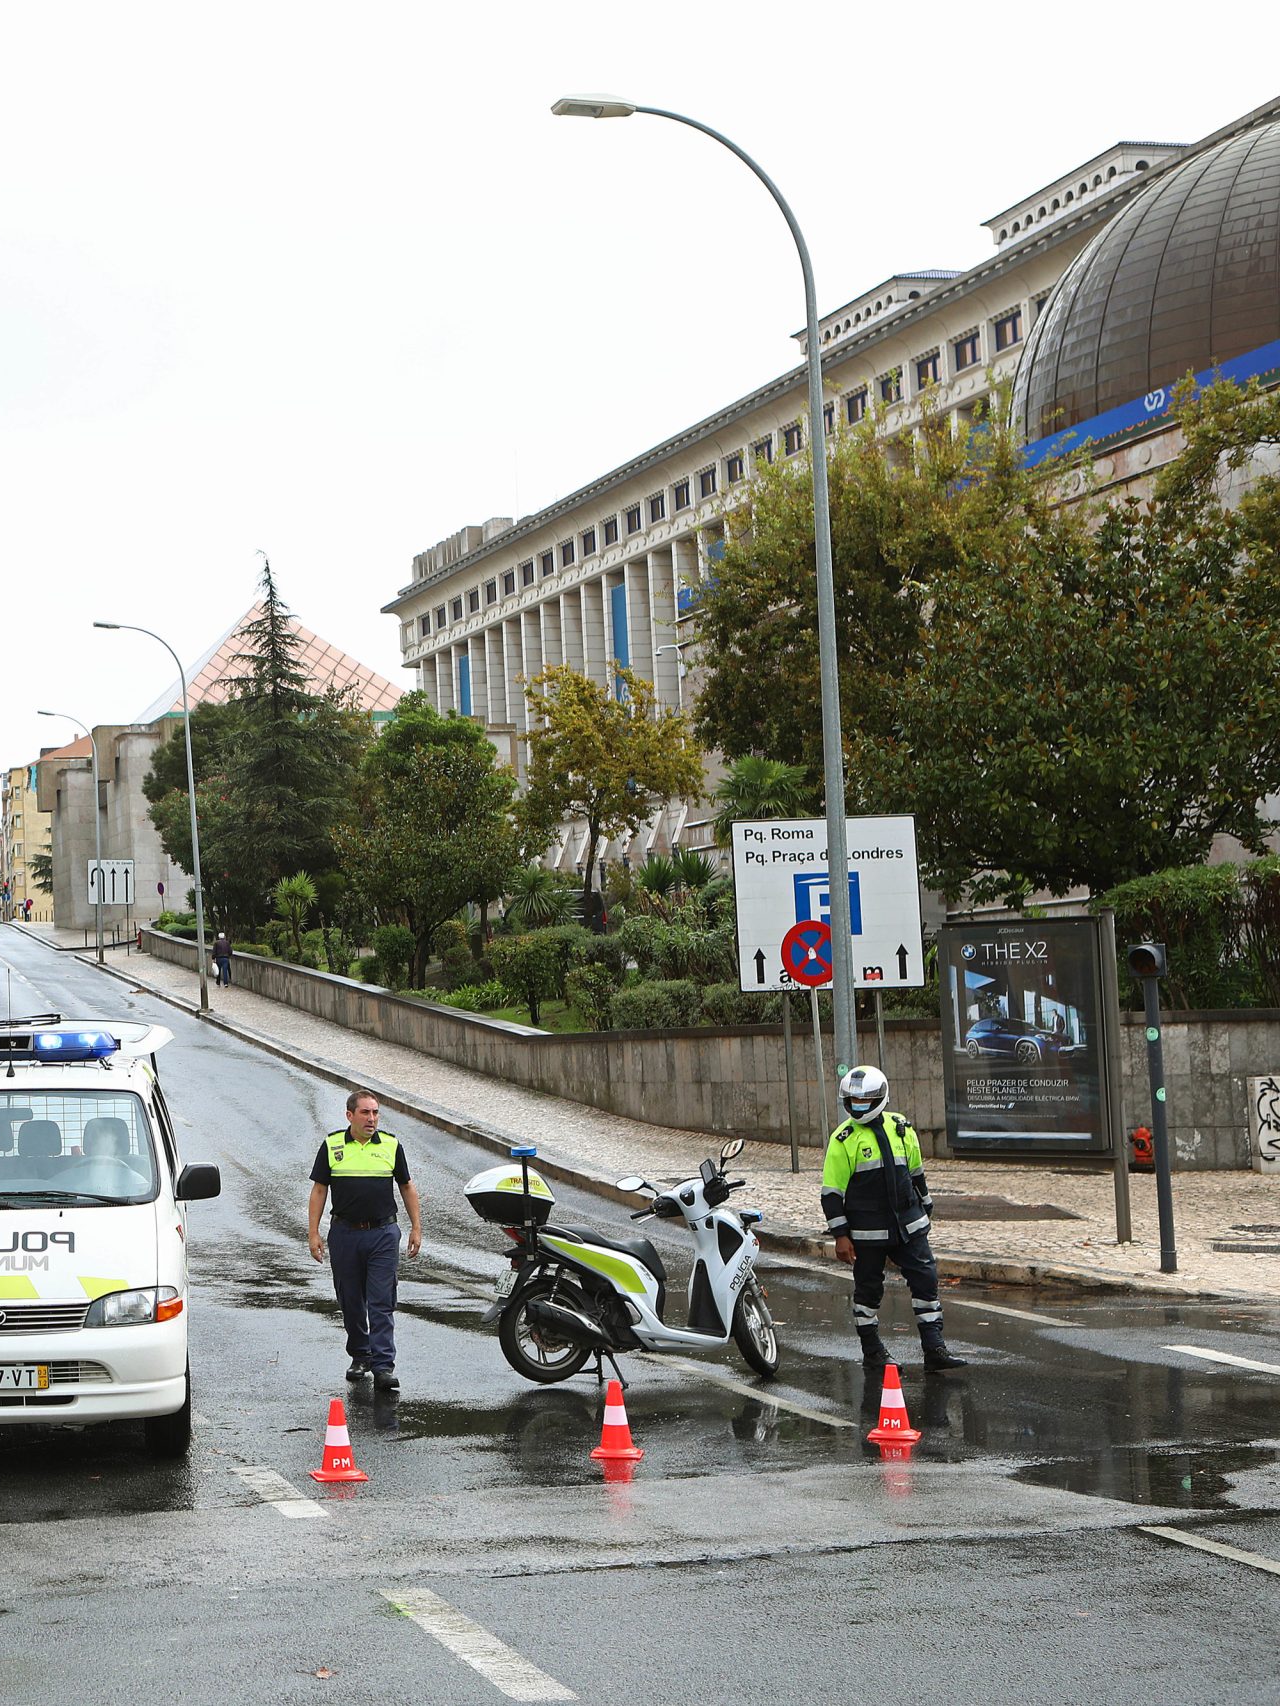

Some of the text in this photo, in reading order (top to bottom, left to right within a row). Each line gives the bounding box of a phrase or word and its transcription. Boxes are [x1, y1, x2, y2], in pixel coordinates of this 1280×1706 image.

[744, 828, 814, 843] Pq. Roma
[745, 851, 768, 866] Pq.
[772, 850, 815, 864] Praça
[981, 941, 1048, 960] THE X2
[966, 1079, 1069, 1087] PELO PRAZER DE CONDUZIR
[992, 1087, 1027, 1095] PLANETA.
[730, 1255, 751, 1291] POLÍCIA
[883, 1418, 901, 1428] PM
[332, 1457, 351, 1468] PM
